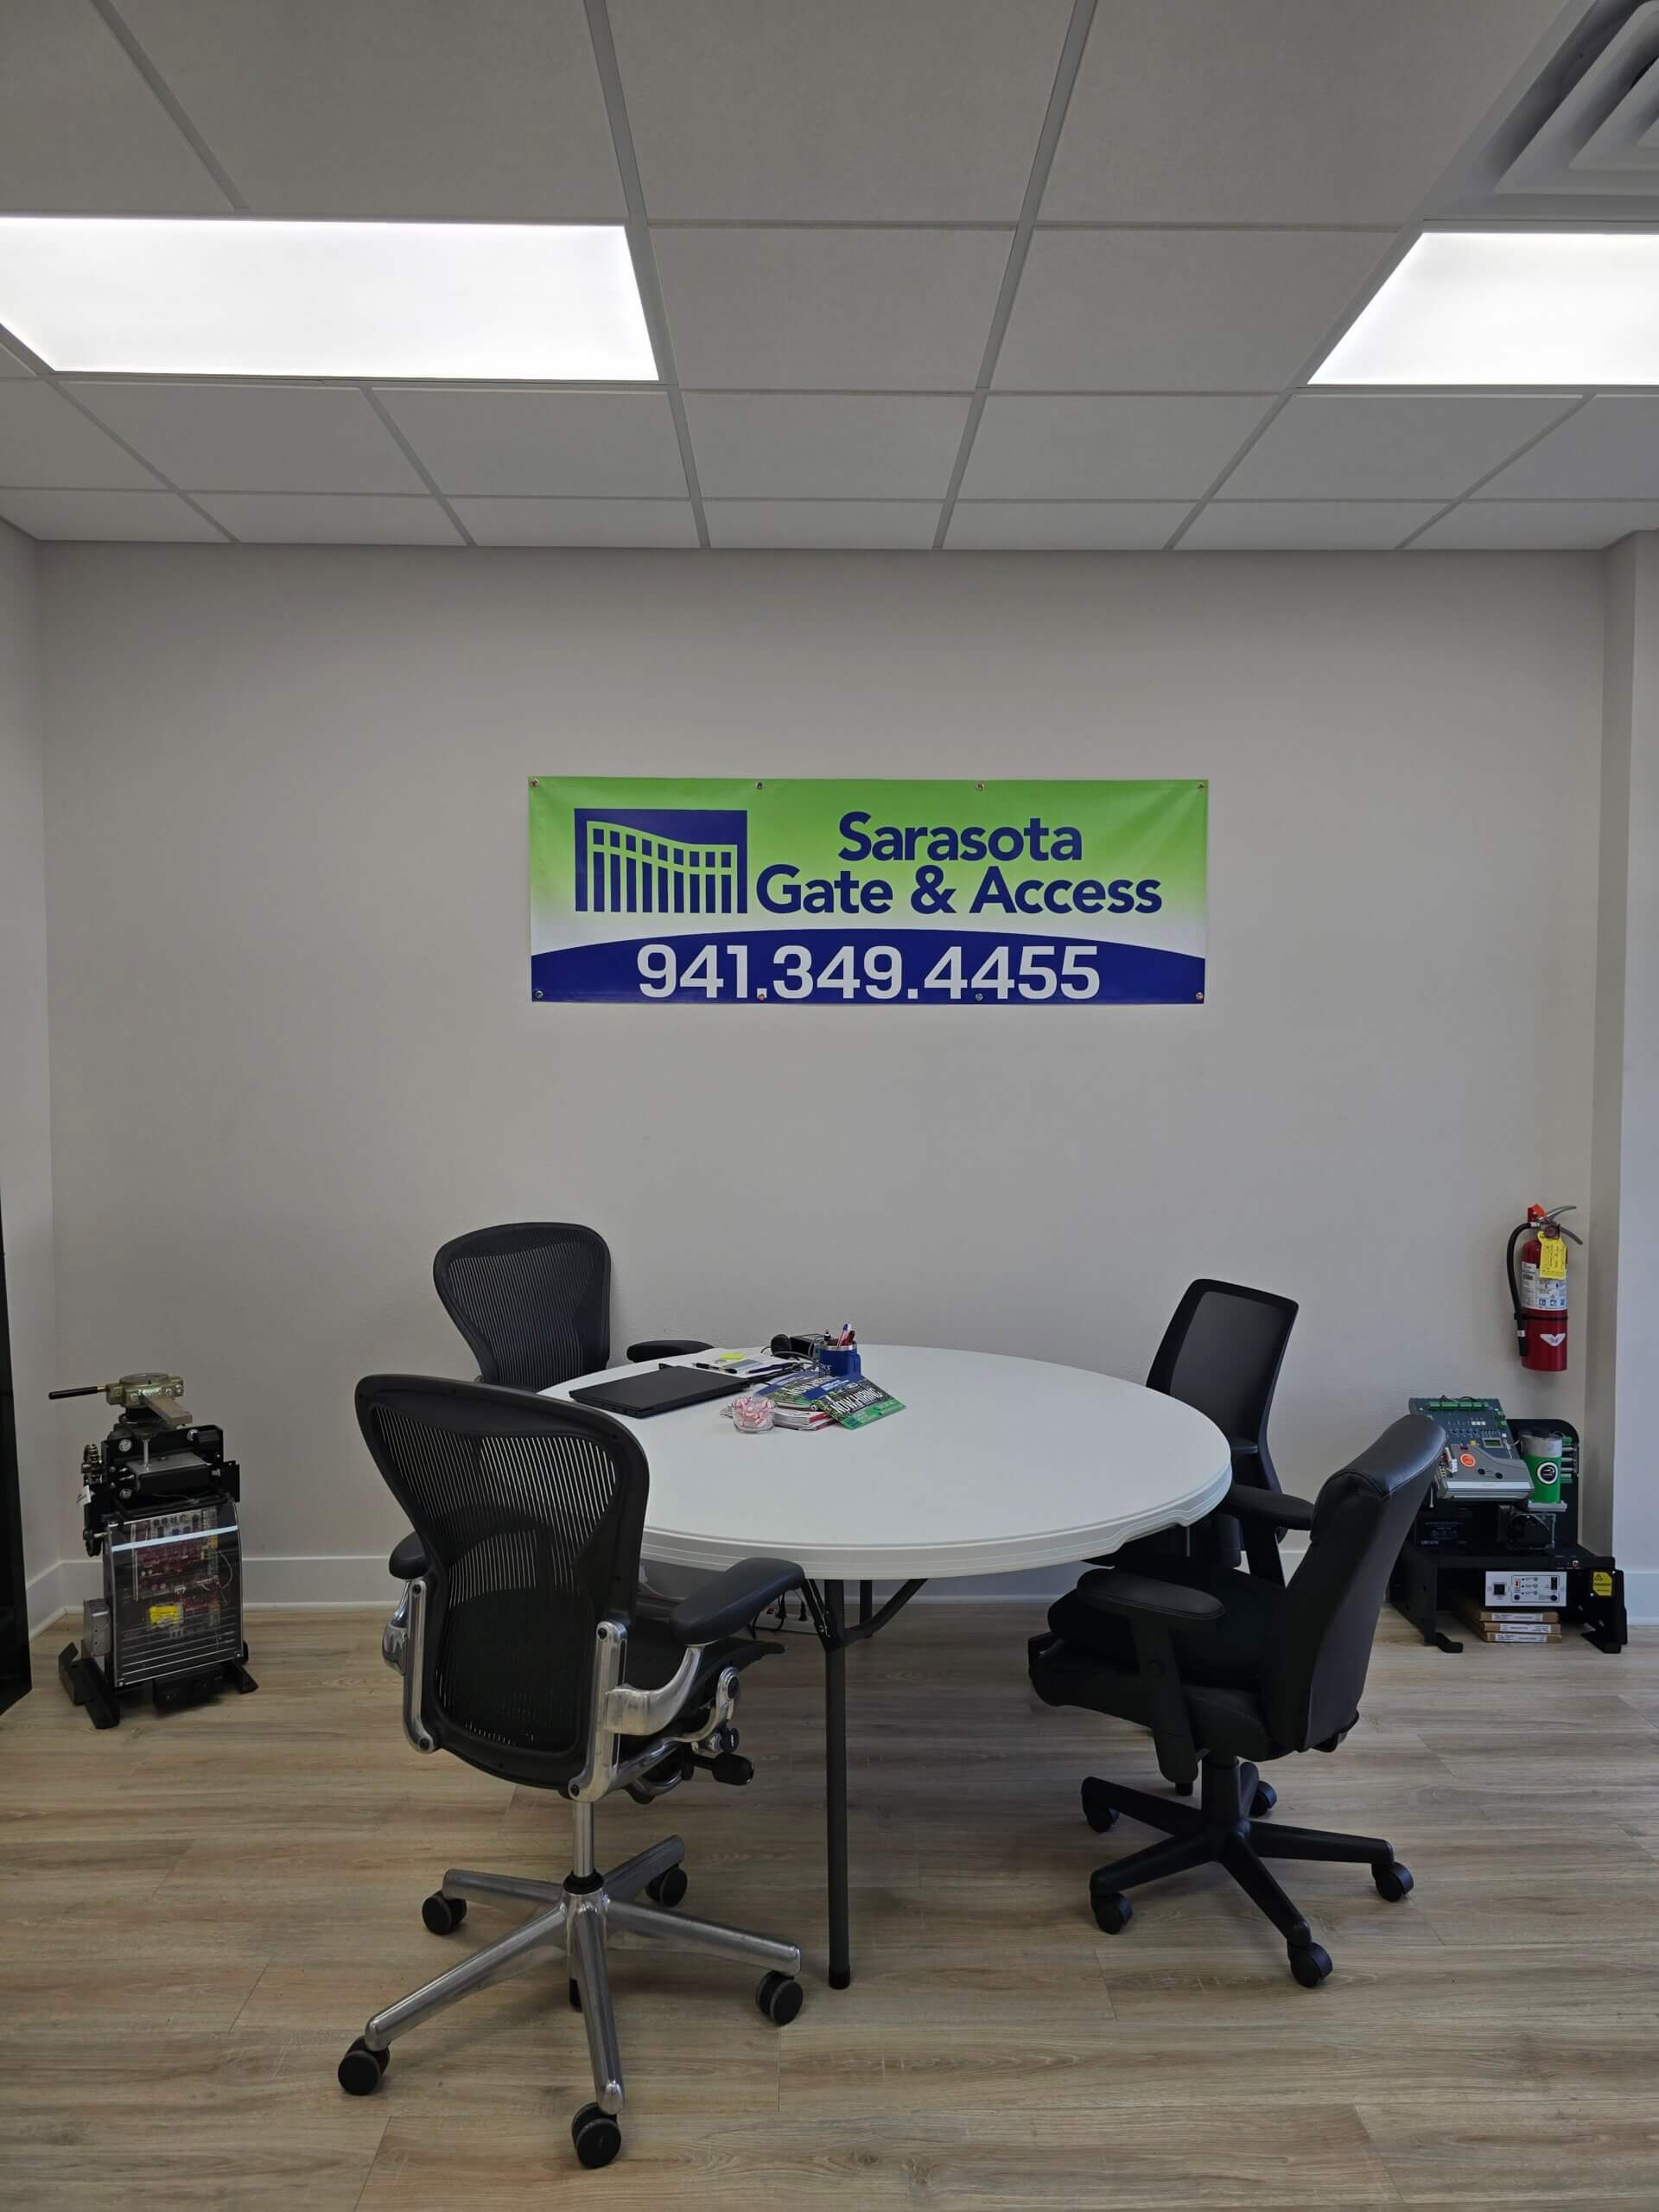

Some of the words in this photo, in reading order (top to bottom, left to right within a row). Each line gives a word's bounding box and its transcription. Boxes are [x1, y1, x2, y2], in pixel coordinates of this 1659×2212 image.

[837, 810, 1083, 861] Sarasota
[756, 864, 893, 914] Gate
[910, 864, 957, 915] &
[969, 865, 1162, 914] Access
[637, 944, 1100, 1000] 941.349.4455
